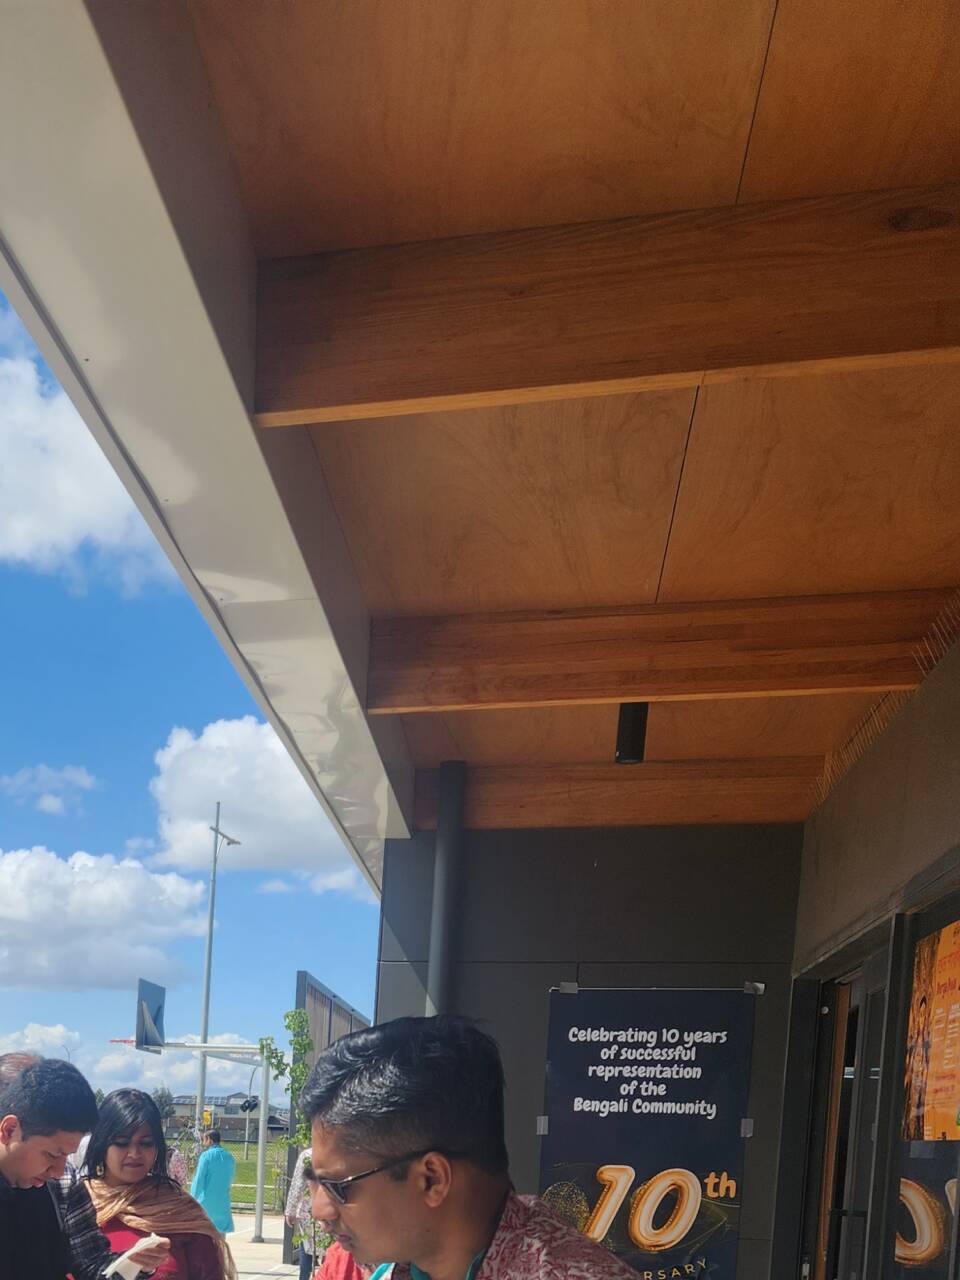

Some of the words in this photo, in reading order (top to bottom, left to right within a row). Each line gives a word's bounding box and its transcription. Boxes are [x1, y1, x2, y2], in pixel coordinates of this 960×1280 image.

[568, 1027, 658, 1046] Celebrating
[662, 1028, 680, 1043] 10
[683, 1030, 727, 1047] years
[600, 1045, 619, 1060] of
[620, 1045, 696, 1061] successful
[588, 1063, 702, 1082] representation
[619, 1080, 638, 1095] of
[640, 1081, 667, 1096] the
[573, 1097, 628, 1118] Bengali
[632, 1098, 717, 1120] Community
[585, 1164, 737, 1251] 10th
[643, 1257, 708, 1280] RSARY
